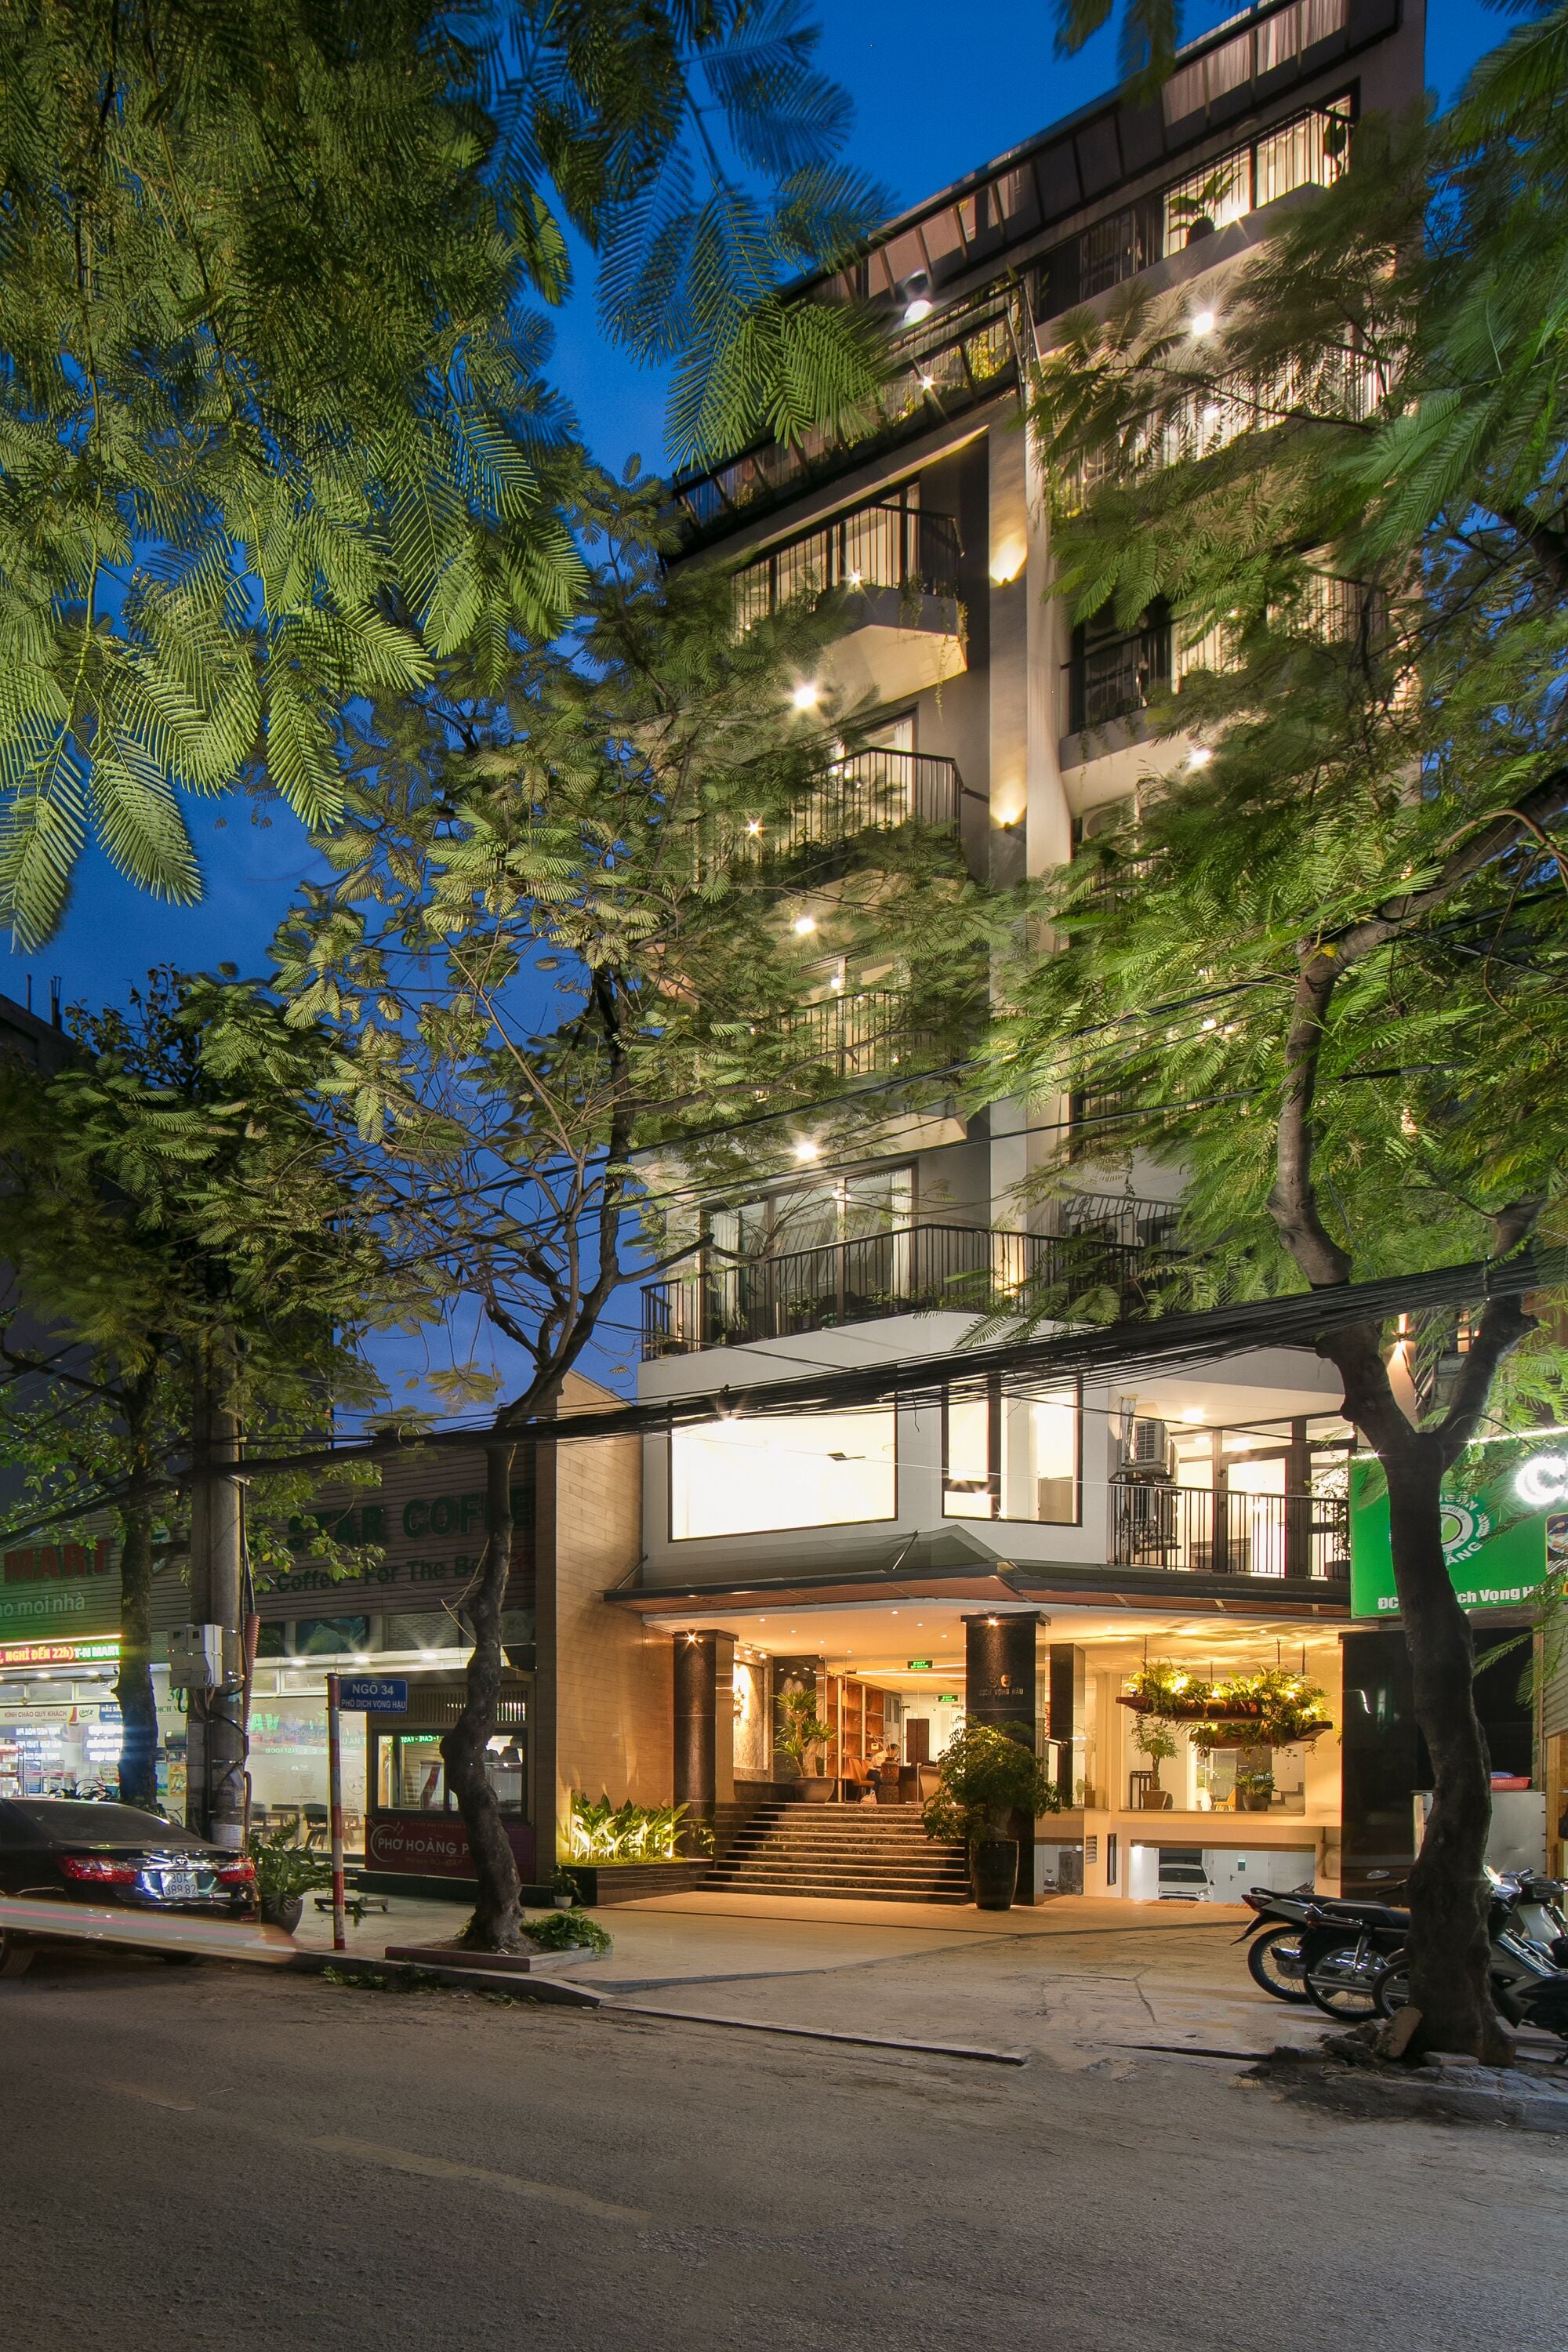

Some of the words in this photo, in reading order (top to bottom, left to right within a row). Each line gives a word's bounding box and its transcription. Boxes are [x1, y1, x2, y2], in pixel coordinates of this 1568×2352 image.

[4, 1539, 110, 1582] MART
[406, 1558, 445, 1581] The
[1479, 1588, 1521, 1604] Vọng
[352, 1682, 378, 1694] NGÕ
[381, 1685, 394, 1695] 34
[356, 1699, 372, 1709] DỊCH
[372, 1700, 391, 1710] VỌNG
[405, 1837, 458, 1854] HOÀNG
